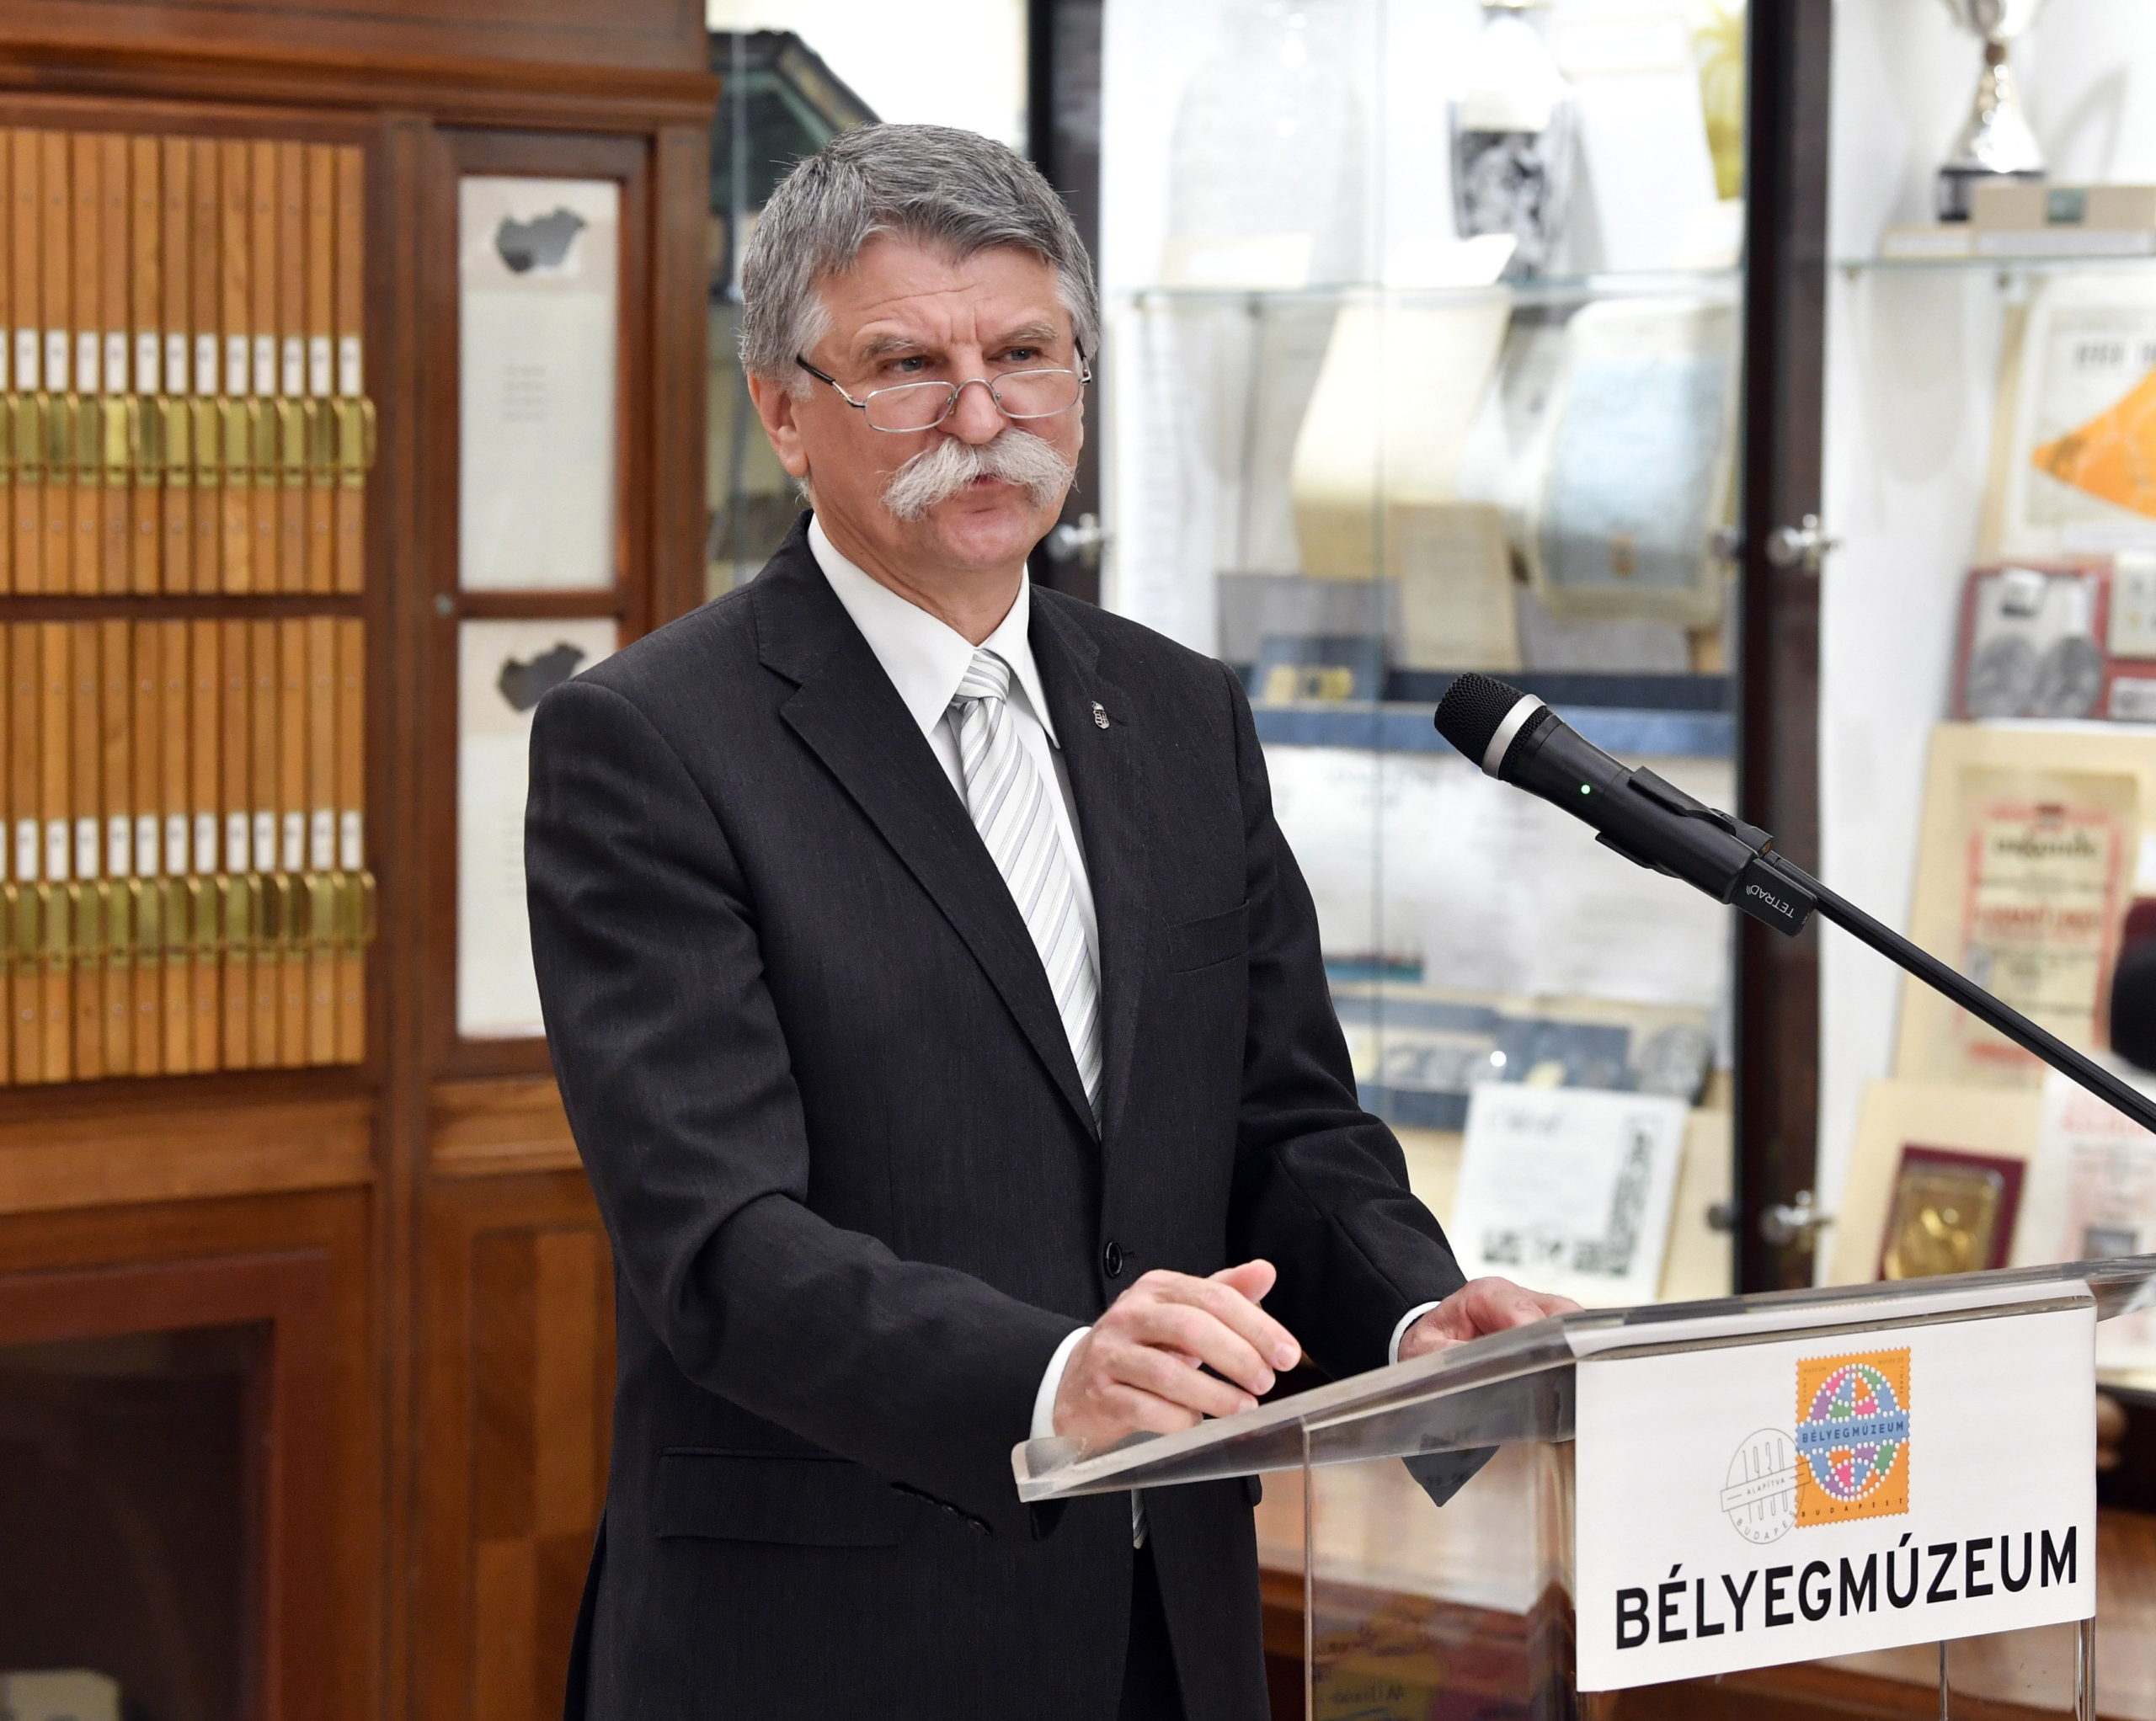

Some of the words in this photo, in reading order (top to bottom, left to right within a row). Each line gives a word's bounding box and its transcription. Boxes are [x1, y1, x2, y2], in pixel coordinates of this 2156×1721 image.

[1750, 885, 1795, 919] TETRAD
[1802, 1420, 1904, 1443] BÉLYEGMÚZEUM
[1746, 1477, 1785, 1495] ALAPÍTVA
[1801, 1498, 1903, 1517] BUDAPEST
[1615, 1526, 2078, 1649] BÉLYEGMÚZEUM
